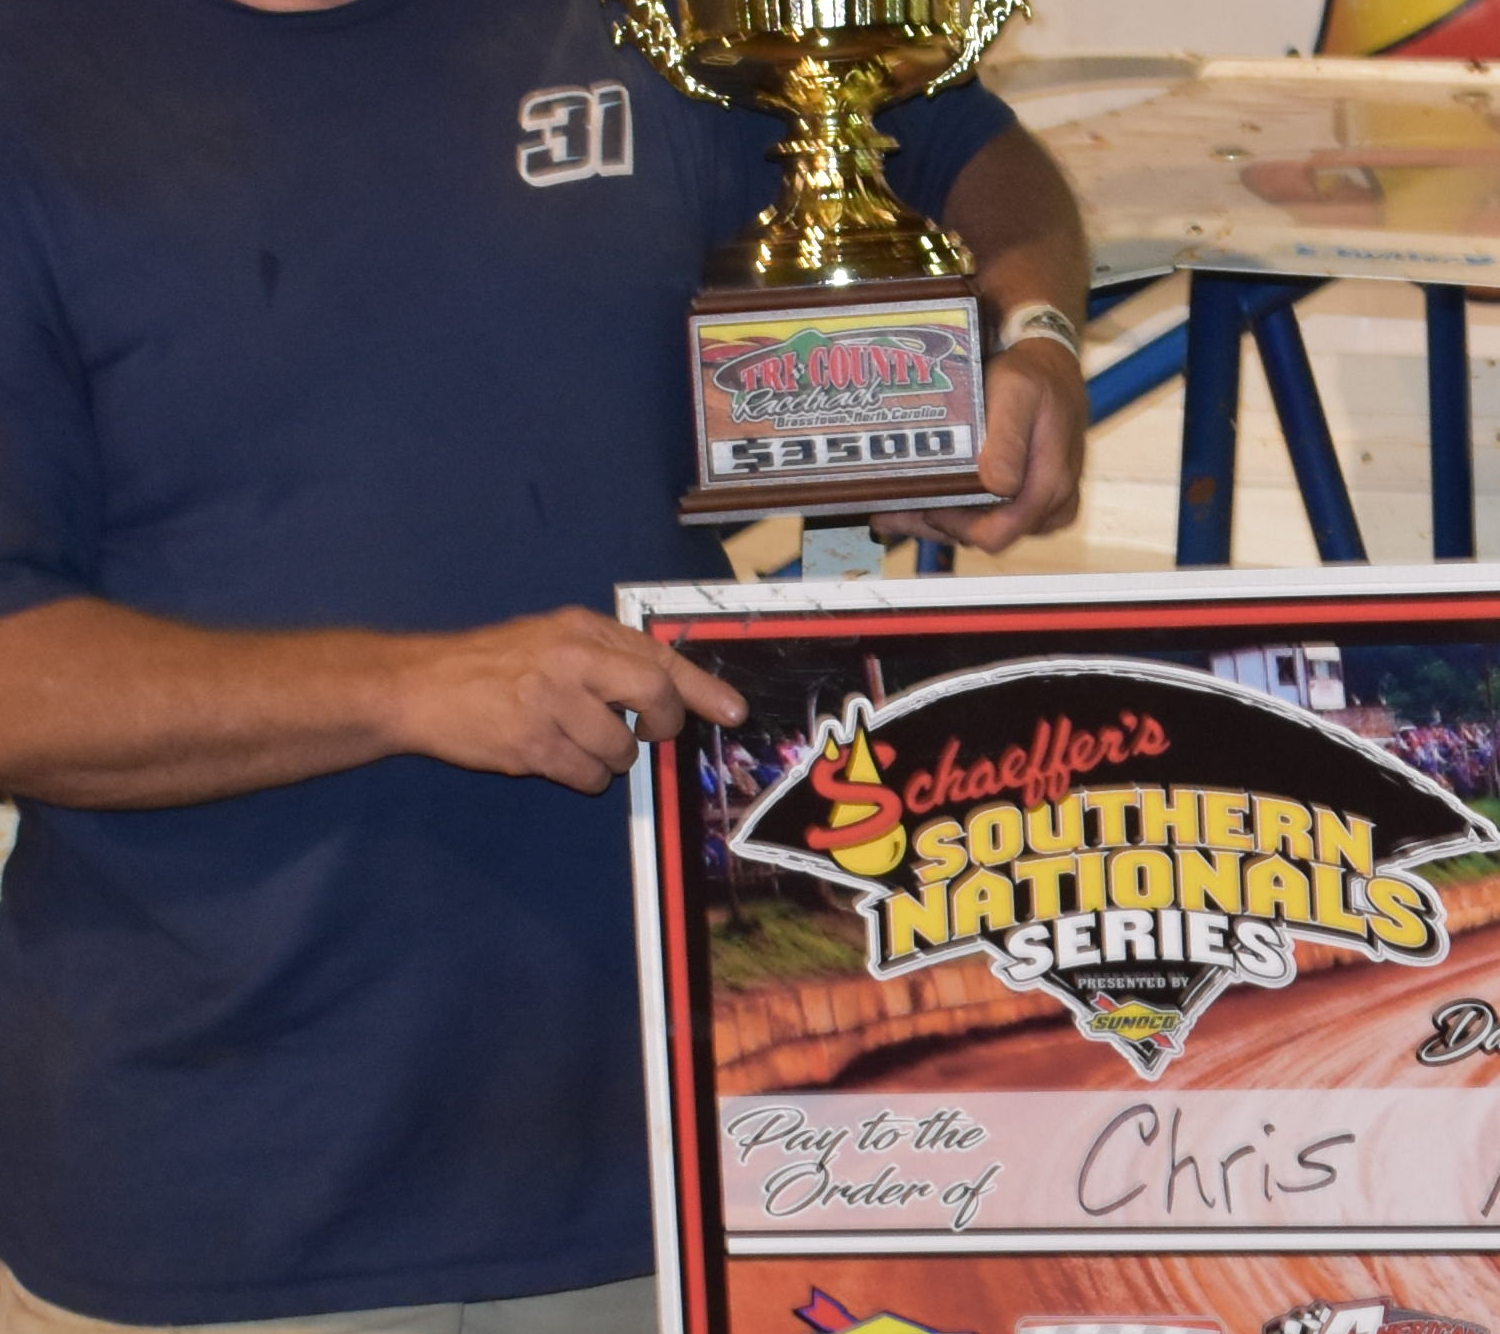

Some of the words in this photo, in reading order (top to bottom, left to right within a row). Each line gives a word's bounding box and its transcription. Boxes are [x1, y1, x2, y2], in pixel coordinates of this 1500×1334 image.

[516, 83, 634, 188] 31
[733, 378, 884, 423] Racetrack
[740, 352, 797, 395] TRI
[807, 341, 936, 390] COUNTY
[853, 409, 890, 424] North
[891, 405, 947, 422] Carolina
[731, 428, 957, 473] $3500
[805, 710, 1172, 851] Schaeffer's
[910, 786, 1377, 880] SOUTHERN
[886, 848, 1437, 960] NATIONALS
[1003, 910, 1289, 985] SERIES
[1076, 975, 1163, 992] PRESENTED
[1168, 974, 1192, 990] BY
[1090, 1011, 1181, 1034] SUNOCO
[728, 1106, 842, 1169] Pay
[861, 1112, 906, 1153] to
[909, 1105, 990, 1154] the
[1075, 1100, 1358, 1220] Chris
[763, 1158, 950, 1218] Order
[950, 1162, 1002, 1232] of
